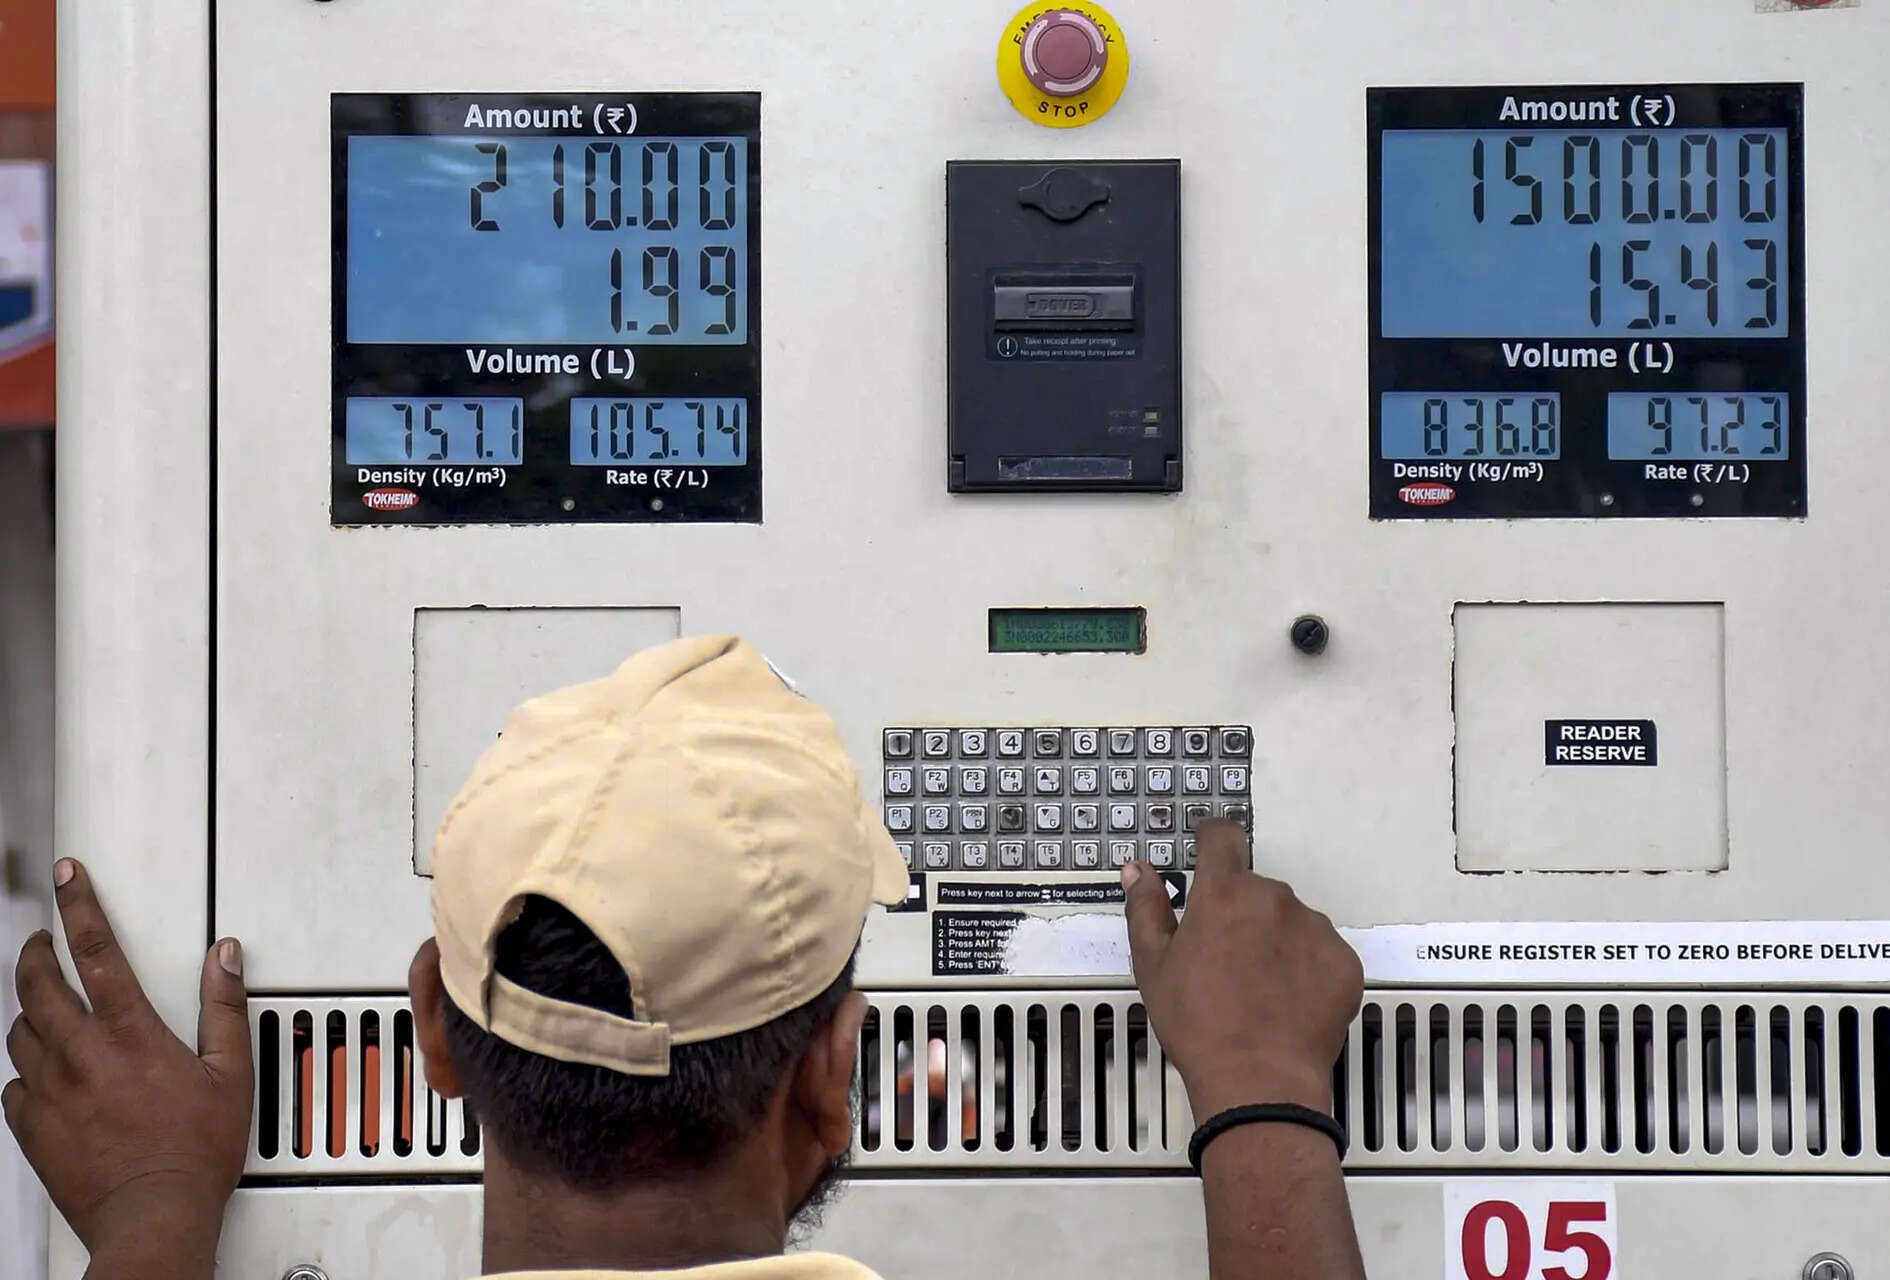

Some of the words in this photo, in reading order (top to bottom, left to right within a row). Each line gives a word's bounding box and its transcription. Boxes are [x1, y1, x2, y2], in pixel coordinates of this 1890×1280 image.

[1038, 101, 1089, 118] STOP
[1499, 96, 1619, 120] Amount
[464, 104, 582, 129] Amount
[471, 142, 736, 231] 210.00
[1473, 134, 1776, 225] 1500.00
[610, 246, 736, 335] 1.99
[1590, 239, 1777, 329] 15.43
[1070, 337, 1087, 345] after
[466, 349, 580, 374] Volume
[1502, 343, 1618, 368] Volume
[392, 403, 519, 460] 757.1
[591, 402, 740, 459] 105.74
[1424, 398, 1556, 456] 836.8
[1648, 397, 1782, 455] 97.23
[357, 468, 426, 487] Density
[606, 469, 648, 485] Rate
[1393, 462, 1462, 481] Density
[1645, 464, 1687, 479] Rate
[362, 492, 417, 507] TOKHEIM
[1399, 487, 1454, 502] TOKHEIM
[1561, 726, 1641, 740] READER
[931, 735, 943, 751] 2
[968, 735, 980, 751] 3
[1005, 735, 1018, 751] 4
[1041, 735, 1054, 751] 5
[1080, 734, 1092, 751] 6
[1117, 734, 1129, 750] 7
[1153, 734, 1167, 750] 8
[1556, 746, 1646, 760] RESERVE
[892, 772, 902, 781] F1
[928, 772, 941, 781] F2
[966, 772, 979, 781] F3
[1004, 772, 1017, 780] F4
[1078, 771, 1090, 780] F5
[1115, 771, 1128, 780] F6
[1152, 771, 1165, 780] F7
[1227, 770, 1240, 779] F9
[929, 810, 942, 818] P2
[930, 846, 943, 855] T2
[968, 846, 980, 855] T3
[1005, 846, 1017, 854] T4
[1042, 846, 1054, 854] T5
[1079, 846, 1092, 854] T6
[1117, 846, 1129, 854] T7
[1154, 846, 1167, 854] T8
[941, 888, 966, 897] Press
[967, 888, 982, 899] key
[985, 889, 1003, 898] next
[1005, 889, 1014, 898] to
[1016, 890, 1040, 898] arrow
[1052, 889, 1064, 898] for
[1066, 889, 1104, 899] selecting
[1106, 887, 1124, 897] side
[938, 919, 946, 927] 1.
[948, 918, 979, 927] Ensure
[938, 929, 946, 937] 2.
[948, 929, 973, 937] Press
[975, 929, 990, 939] key
[938, 939, 946, 948] 3.
[948, 939, 973, 948] Press
[975, 939, 995, 948] AMT
[938, 950, 946, 958] 4.
[948, 950, 972, 958] Enter
[1416, 945, 1492, 960] ENSURE
[1499, 945, 1596, 960] REGISTER
[1603, 945, 1638, 960] SET
[1645, 945, 1671, 960] TO
[1678, 945, 1729, 960] ZERO
[1737, 944, 1813, 959] BEFORE
[1821, 944, 1890, 959] DELIVE
[938, 961, 946, 969] 5.
[948, 960, 973, 969] Press
[1461, 1200, 1612, 1280] 05
